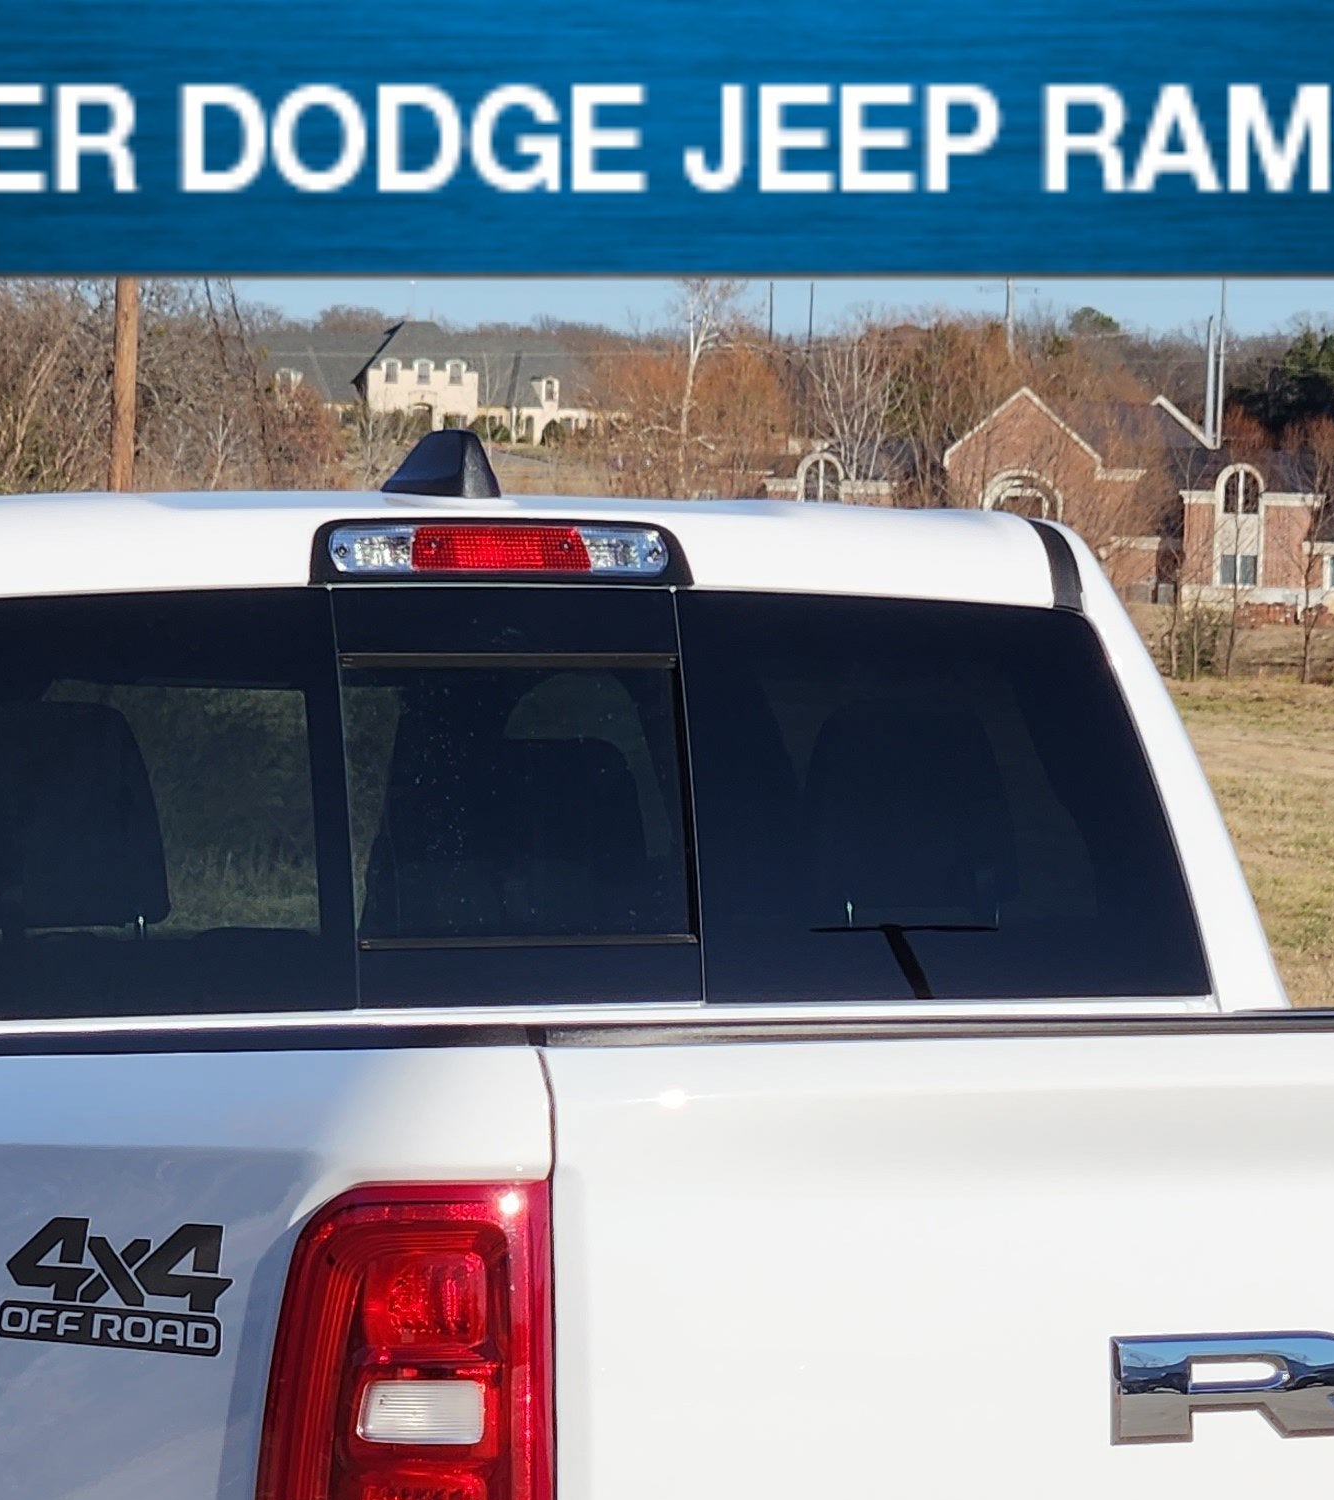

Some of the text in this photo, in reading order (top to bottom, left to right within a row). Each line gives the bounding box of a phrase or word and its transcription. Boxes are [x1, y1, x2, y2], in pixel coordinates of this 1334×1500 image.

[6, 1216, 233, 1314] 4x4
[1, 1305, 218, 1352] OFF ROAD
